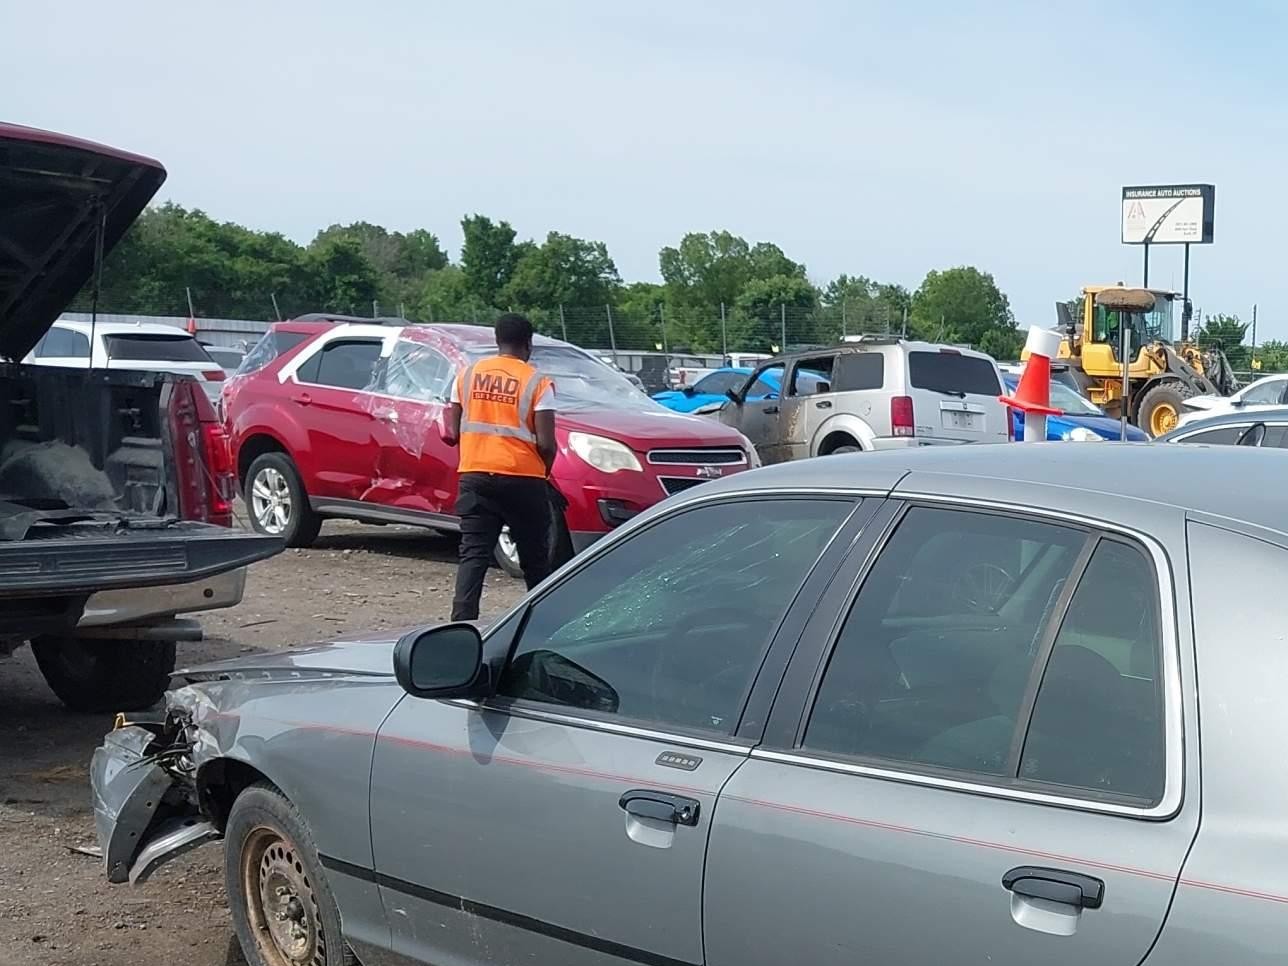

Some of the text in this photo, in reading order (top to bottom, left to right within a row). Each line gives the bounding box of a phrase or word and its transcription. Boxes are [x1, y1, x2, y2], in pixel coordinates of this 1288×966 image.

[1157, 189, 1172, 197] AUTO
[1173, 188, 1201, 196] AUCTIONS
[473, 373, 520, 395] MAD
